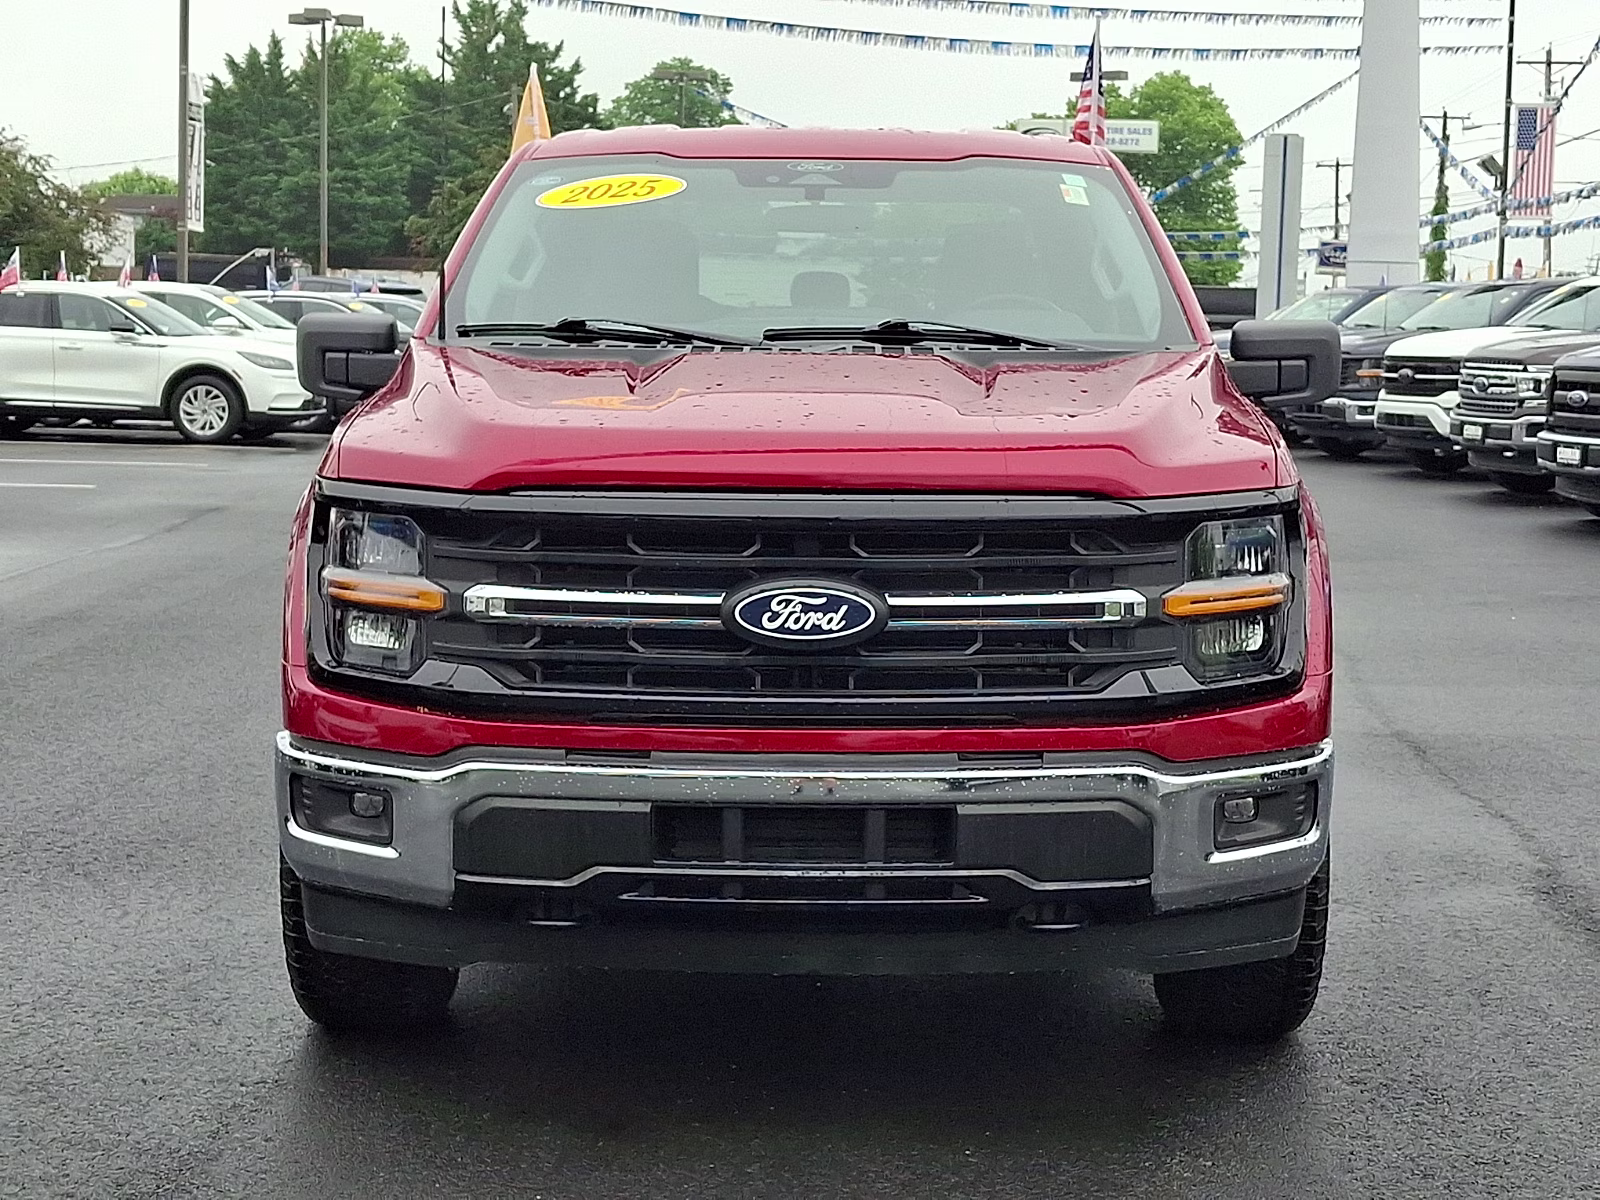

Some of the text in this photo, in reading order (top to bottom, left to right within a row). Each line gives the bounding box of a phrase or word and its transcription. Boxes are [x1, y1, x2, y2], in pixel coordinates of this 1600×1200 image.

[1127, 127, 1153, 136] SALES
[560, 179, 662, 204] 2025
[761, 594, 849, 632] Ford
